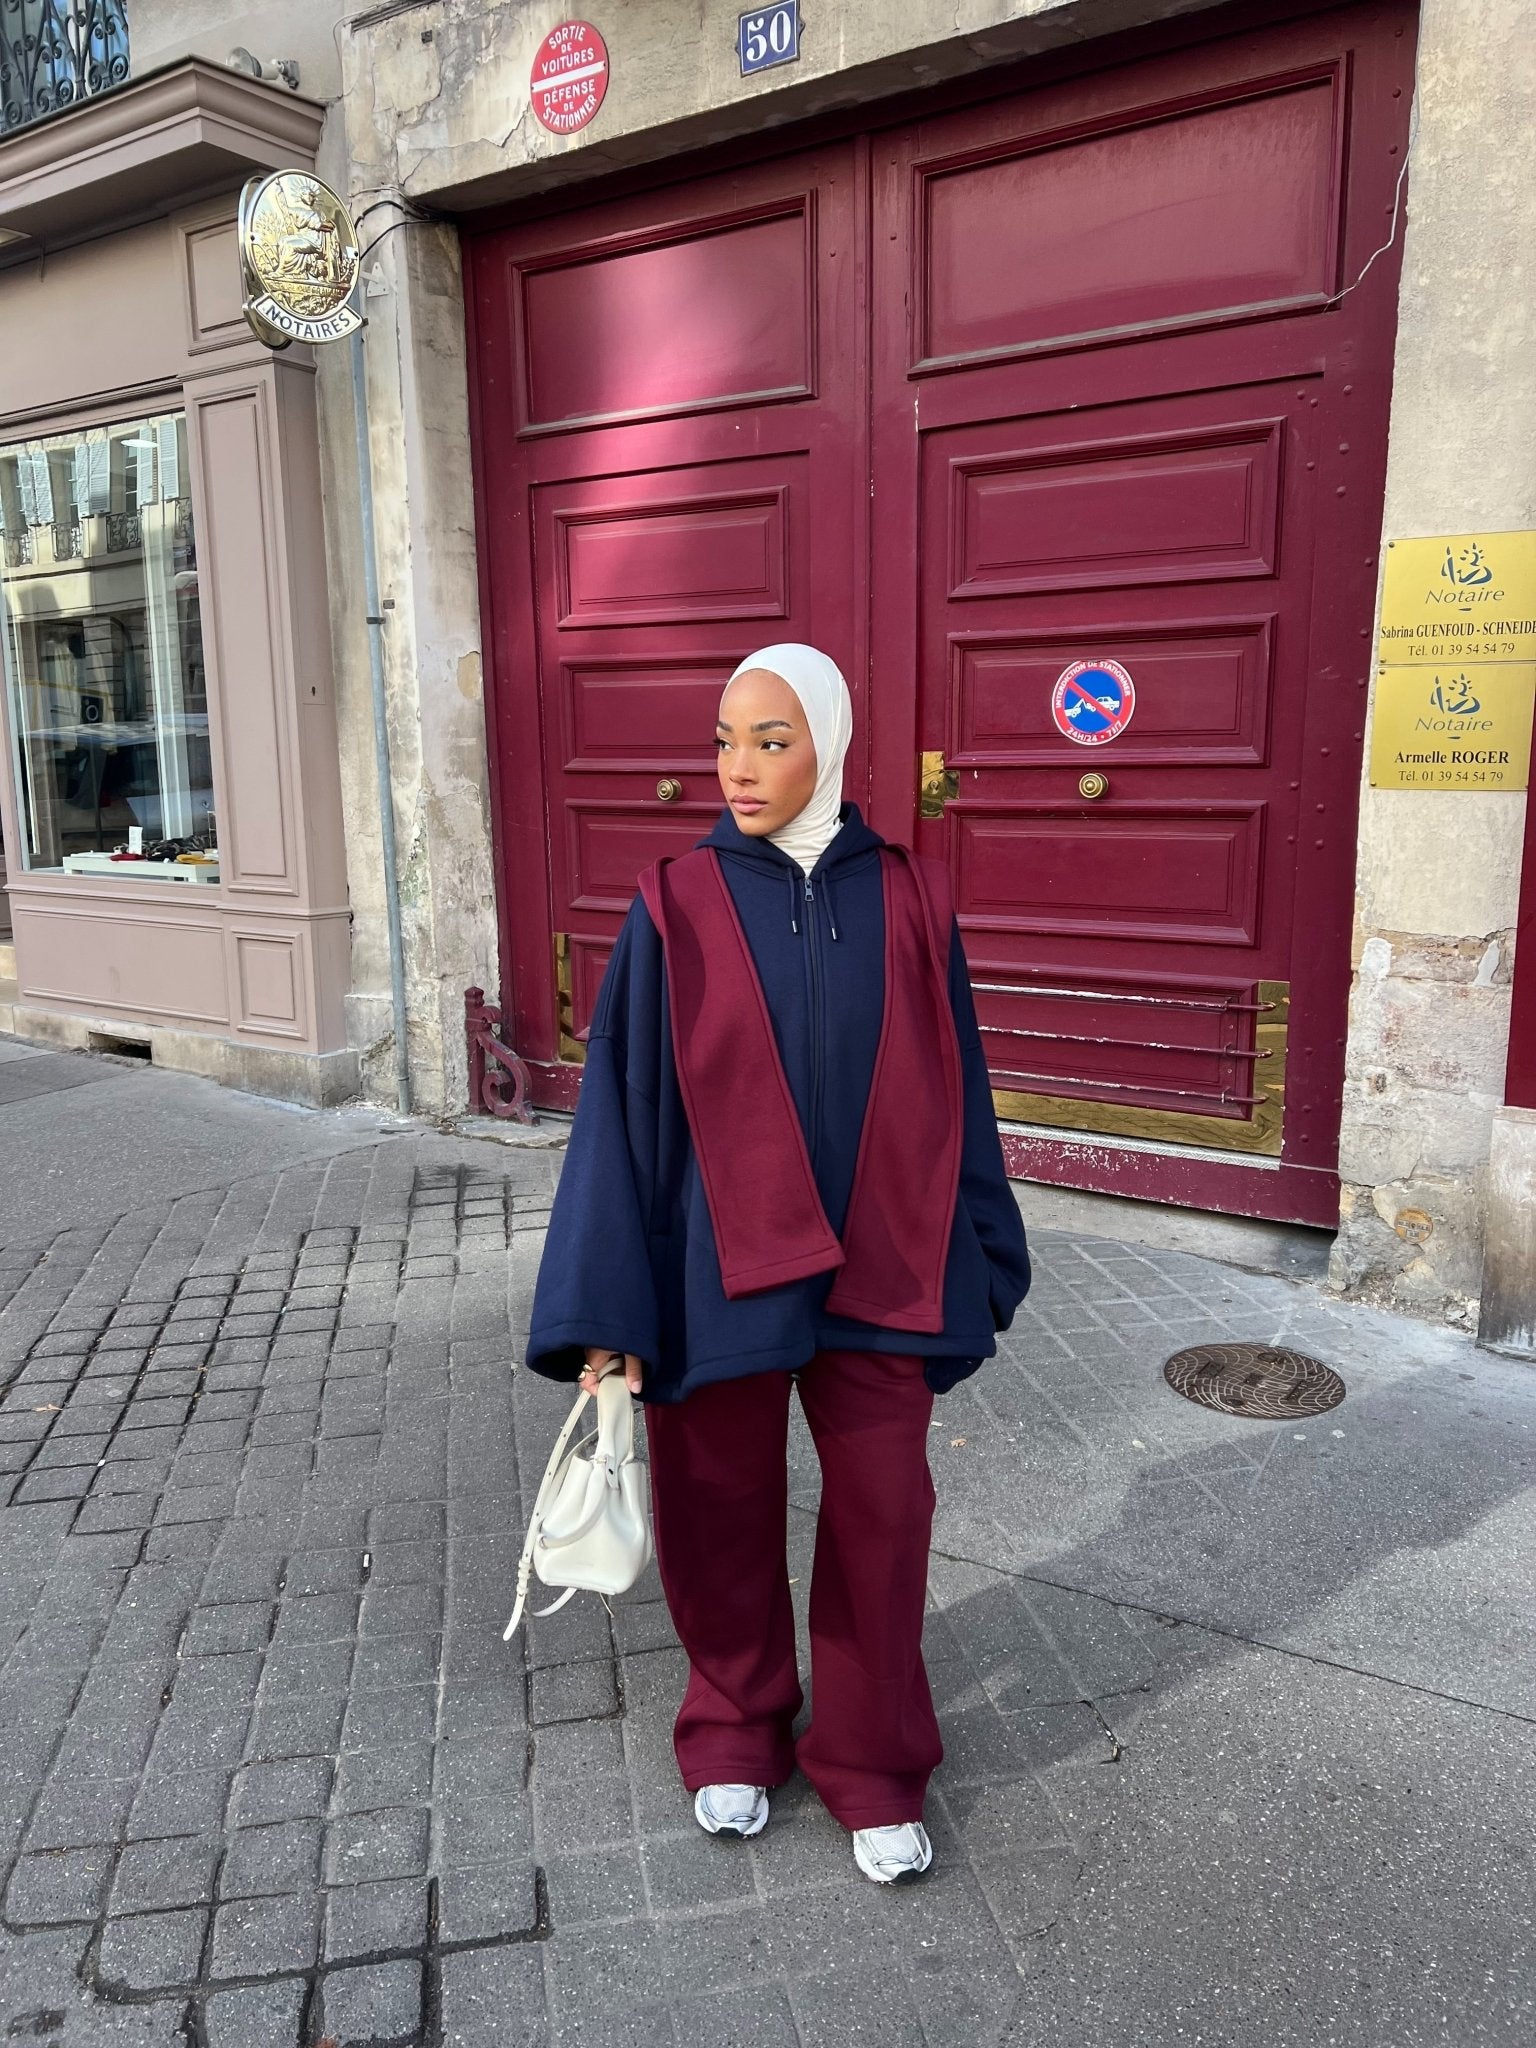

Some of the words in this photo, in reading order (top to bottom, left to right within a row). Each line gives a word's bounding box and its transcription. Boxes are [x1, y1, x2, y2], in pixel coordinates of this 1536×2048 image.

[548, 25, 586, 50] SORTIE
[745, 10, 791, 61] 50
[561, 42, 573, 53] DE
[541, 47, 595, 75] VOITURES
[543, 79, 595, 106] DÉFENSE
[543, 94, 597, 128] STATIONNER
[563, 101, 574, 112] DE
[265, 304, 351, 339] NOTAIRES
[1425, 587, 1505, 604] Notaire
[1380, 626, 1414, 639] Sabrina
[1416, 623, 1474, 637] GUENFOUD
[1407, 645, 1428, 656] Tél.
[1431, 645, 1444, 656] 01
[1448, 644, 1462, 655] 39
[1466, 644, 1479, 655] 54
[1483, 643, 1497, 654] 54
[1501, 642, 1515, 654] 79
[1055, 663, 1086, 708] INTERDICTION
[1099, 661, 1131, 696] STATIONNER
[1414, 717, 1493, 732] Notaire
[1066, 727, 1098, 742] 24H/24
[1394, 751, 1447, 763] Armelle
[1451, 751, 1509, 764] ROGER
[1398, 770, 1418, 781] Tél.
[1421, 771, 1434, 781] 01
[1439, 771, 1452, 781] 39
[1455, 771, 1469, 781] 54
[1472, 771, 1485, 782] 54
[1490, 771, 1504, 782] 79
